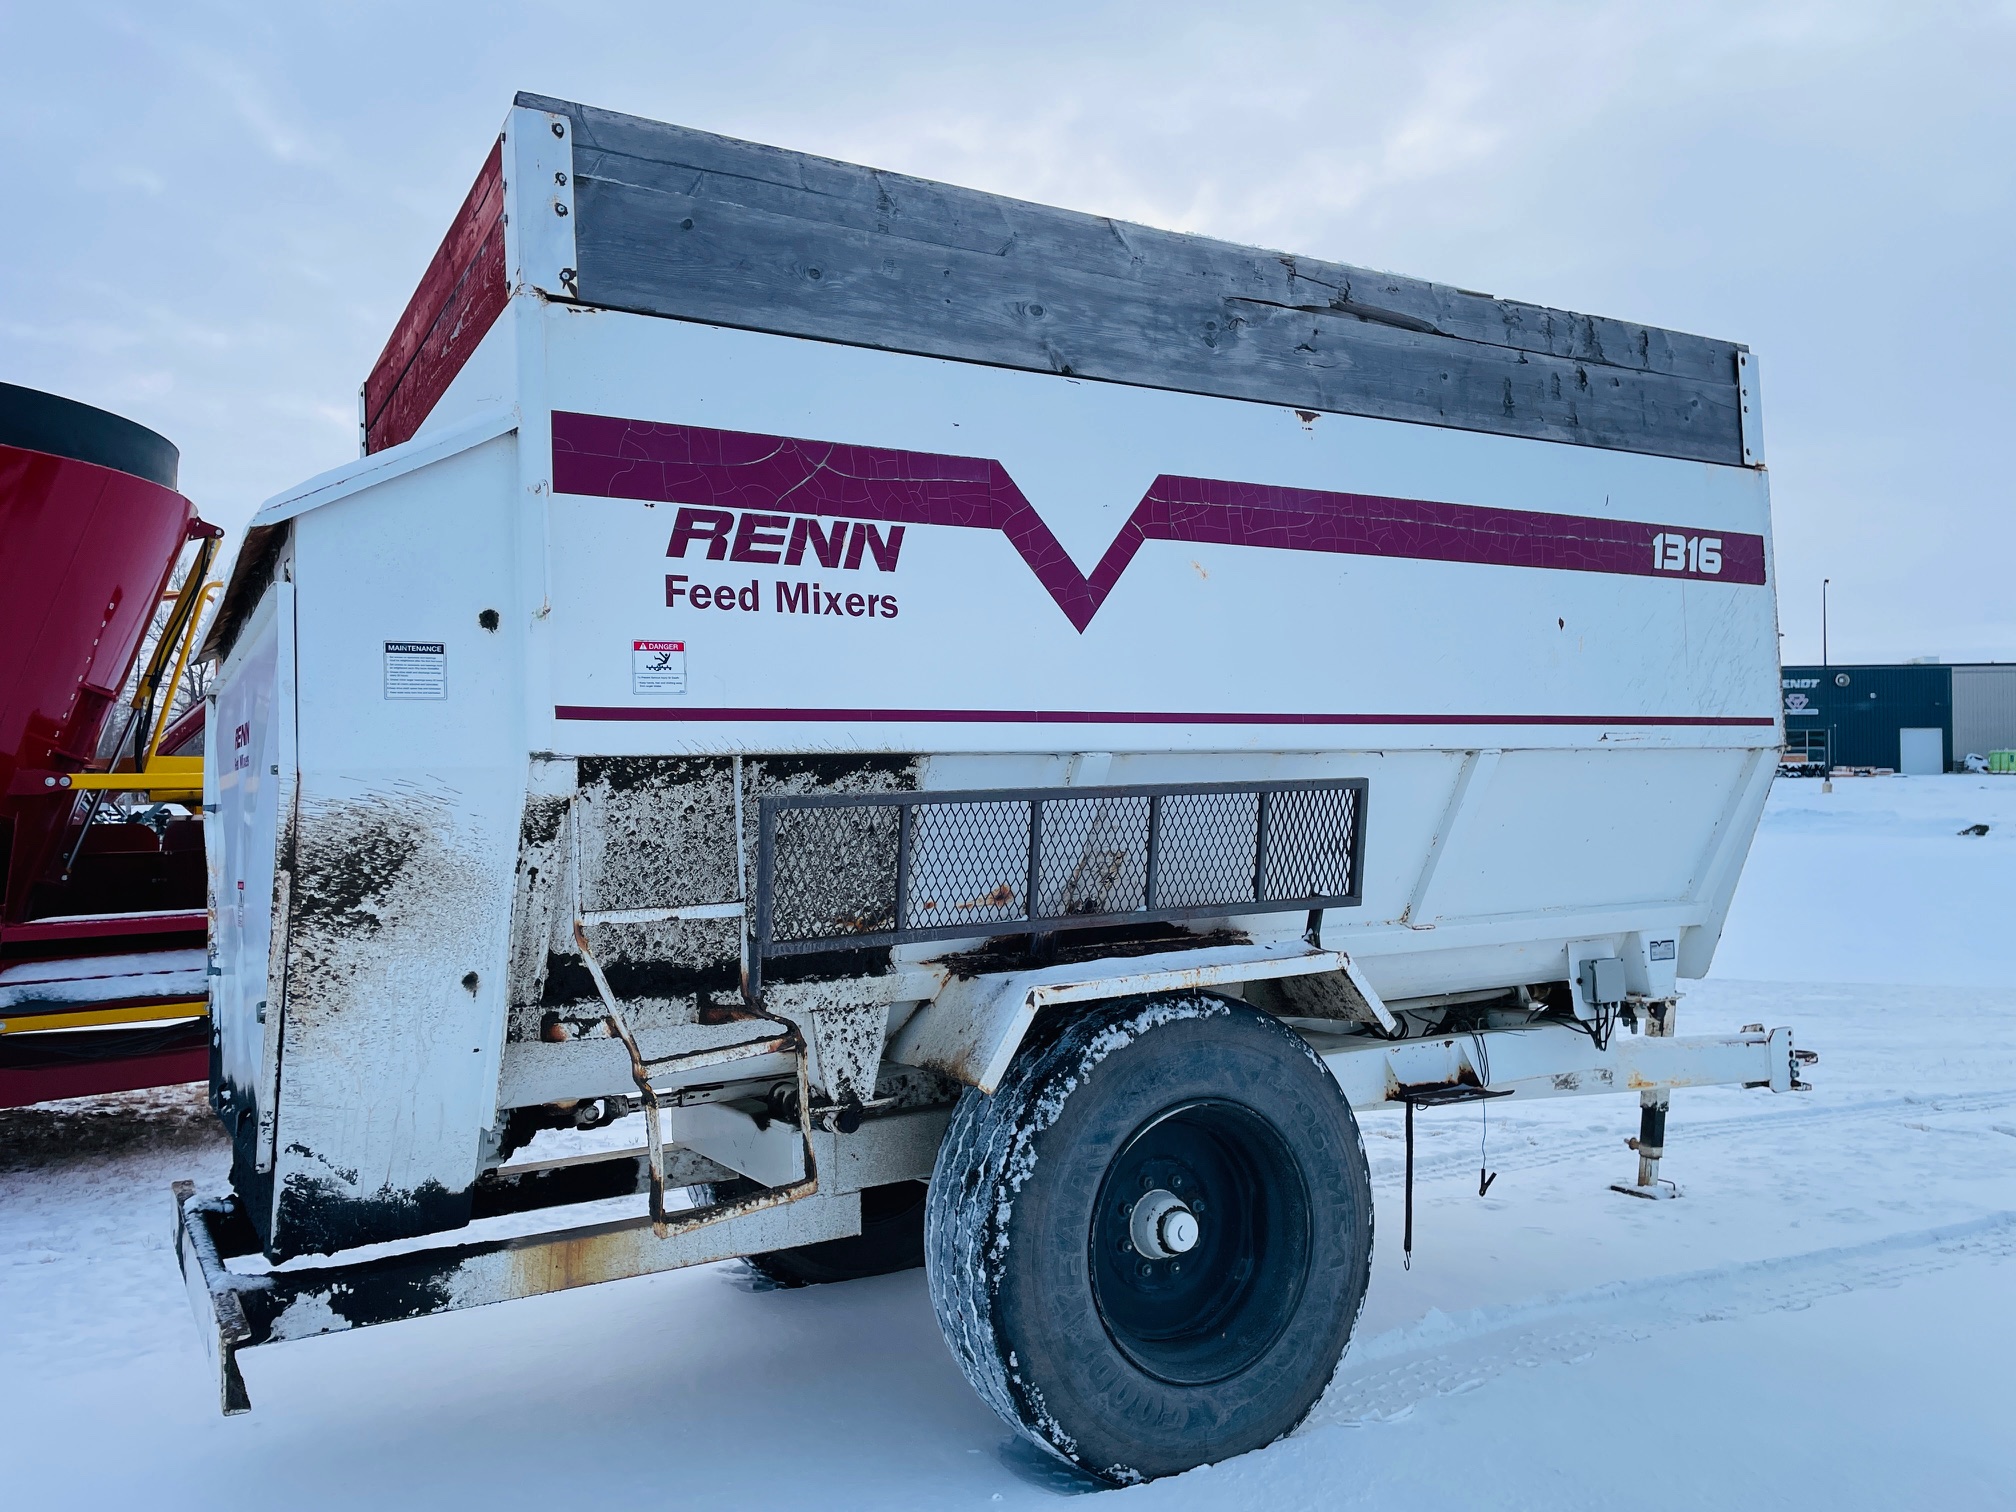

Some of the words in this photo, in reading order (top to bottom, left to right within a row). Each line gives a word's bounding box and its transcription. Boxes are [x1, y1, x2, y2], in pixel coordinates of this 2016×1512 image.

[666, 507, 906, 572] RENN
[1653, 533, 1722, 574] 1316
[665, 574, 760, 612] Feed
[776, 581, 899, 619] Mixers
[388, 645, 442, 653] MAINTENANCE
[1782, 679, 1820, 688] ENDT
